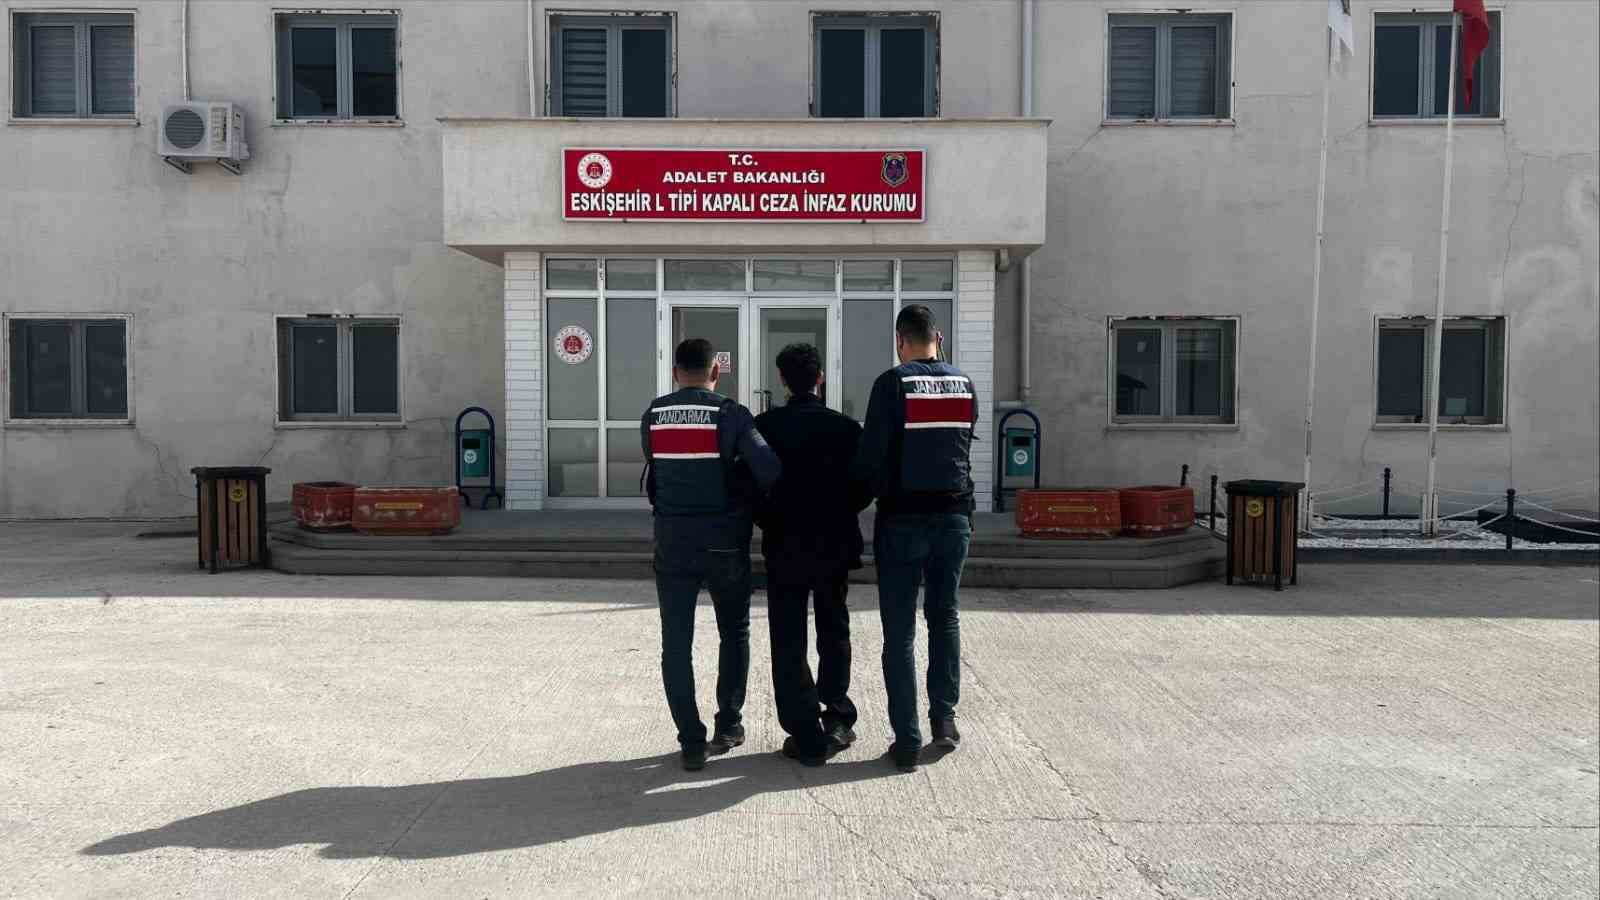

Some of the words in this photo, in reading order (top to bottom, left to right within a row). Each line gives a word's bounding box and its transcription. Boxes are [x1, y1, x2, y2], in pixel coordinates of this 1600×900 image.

[729, 154, 758, 165] T.C.
[662, 171, 728, 183] ADALET
[733, 169, 825, 183] BAKANLIĞI
[570, 189, 651, 215] ESKİŞEHİR
[655, 194, 665, 212] L
[668, 189, 697, 212] TİPİ
[702, 194, 755, 212] KAPALI
[759, 193, 800, 212] CEZA
[803, 189, 847, 212] İNFAZ
[850, 194, 917, 212] KURUMU
[914, 381, 967, 393] JANDARMA
[655, 410, 711, 424] JANDARMA
